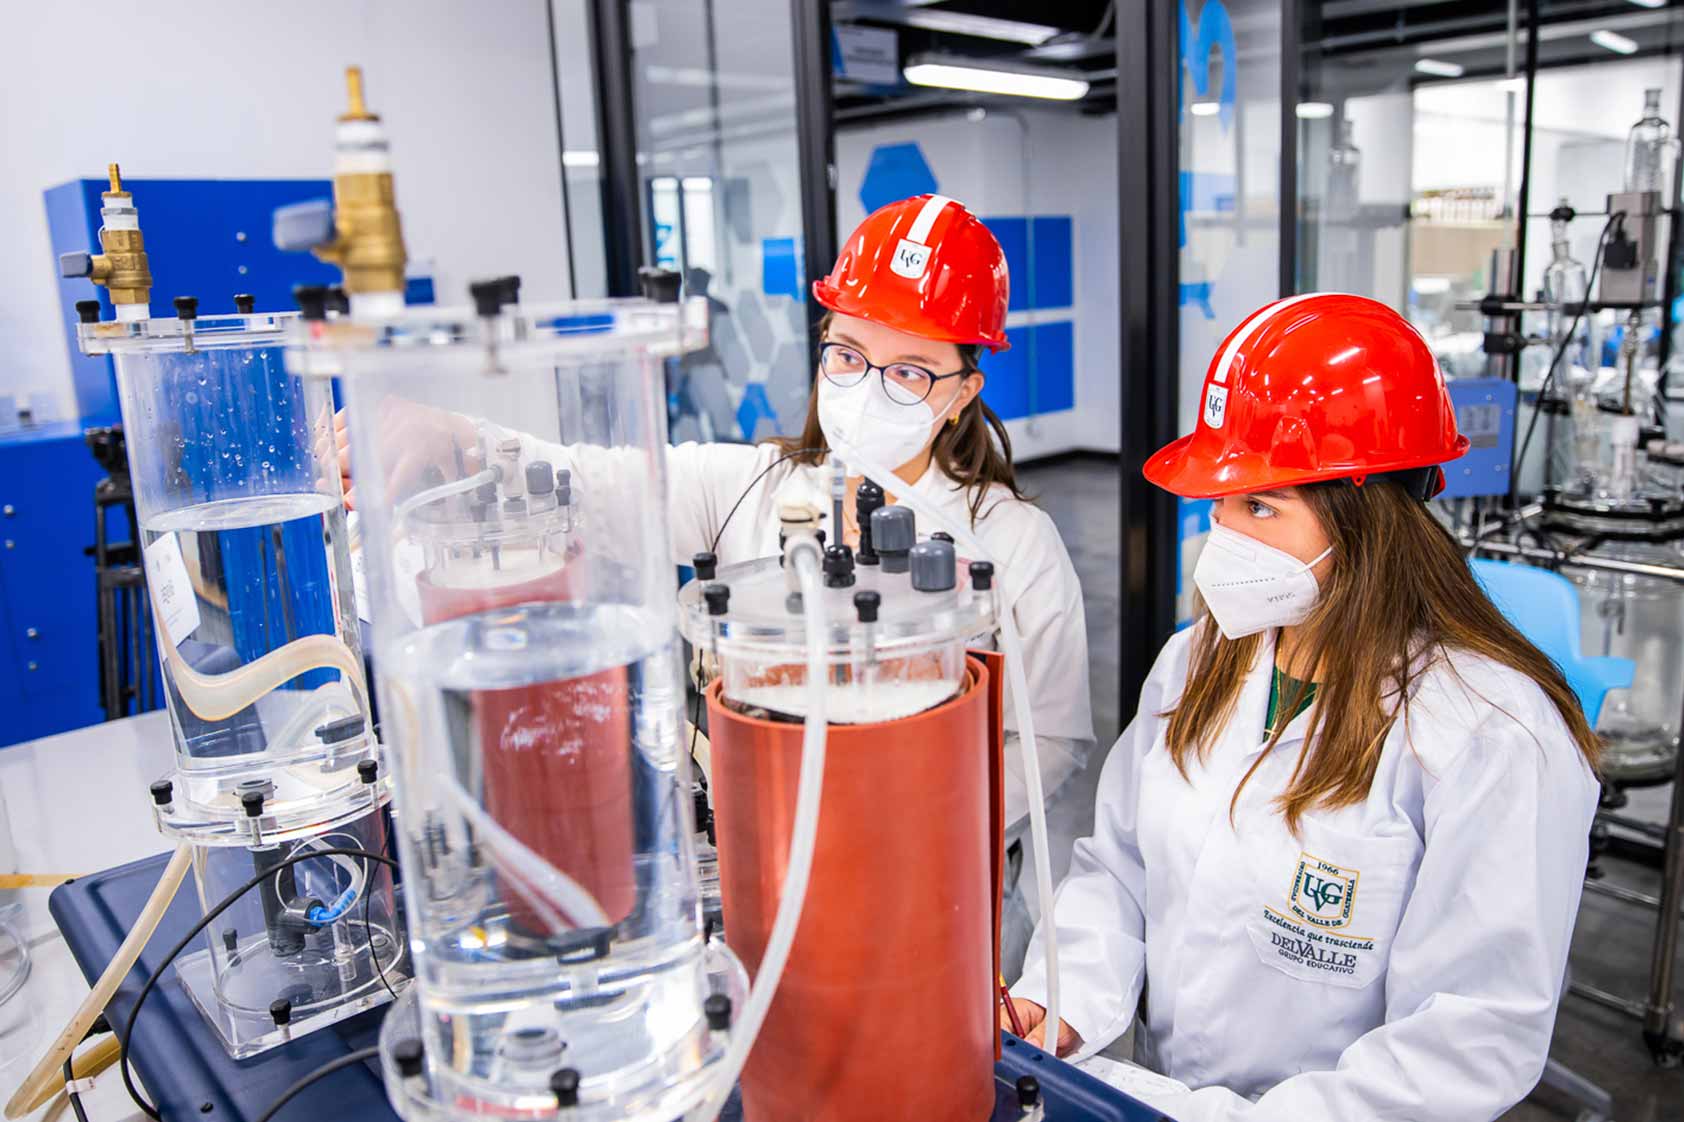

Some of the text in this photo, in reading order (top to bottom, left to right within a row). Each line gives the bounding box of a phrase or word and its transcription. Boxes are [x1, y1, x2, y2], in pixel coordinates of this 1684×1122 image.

[1317, 862, 1339, 876] 1966
[1303, 872, 1343, 912] UVG
[1292, 905, 1343, 927] DEL VALLE DE
[1263, 909, 1374, 951] Excelencia que trasciende
[1278, 949, 1354, 975] GRUPO EDUCATIVO
